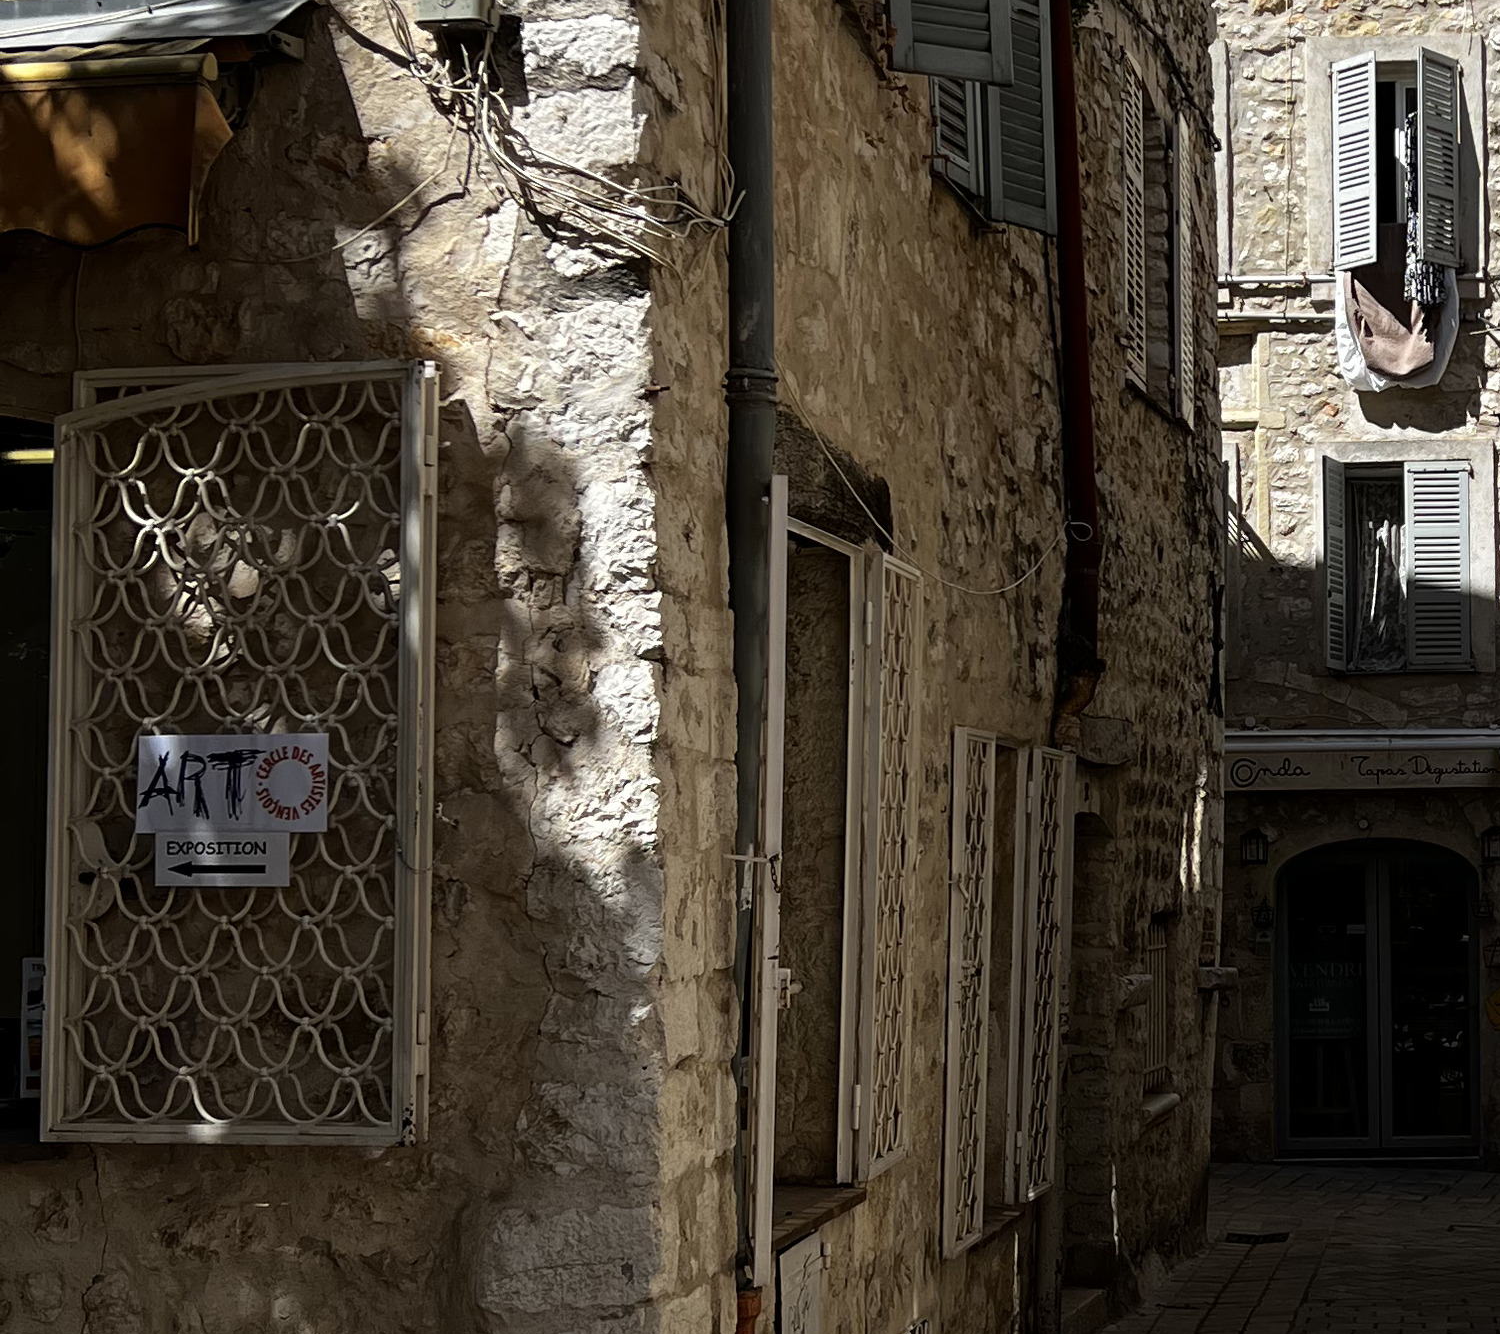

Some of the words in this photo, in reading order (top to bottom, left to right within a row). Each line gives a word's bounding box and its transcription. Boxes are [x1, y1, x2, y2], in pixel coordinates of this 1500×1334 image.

[256, 746, 289, 780] CERCLE
[291, 745, 314, 765] DES
[1350, 756, 1407, 784] Tapas
[138, 748, 267, 821] ART
[300, 763, 326, 816] ARTISTES
[166, 840, 267, 856] EXPOSITION
